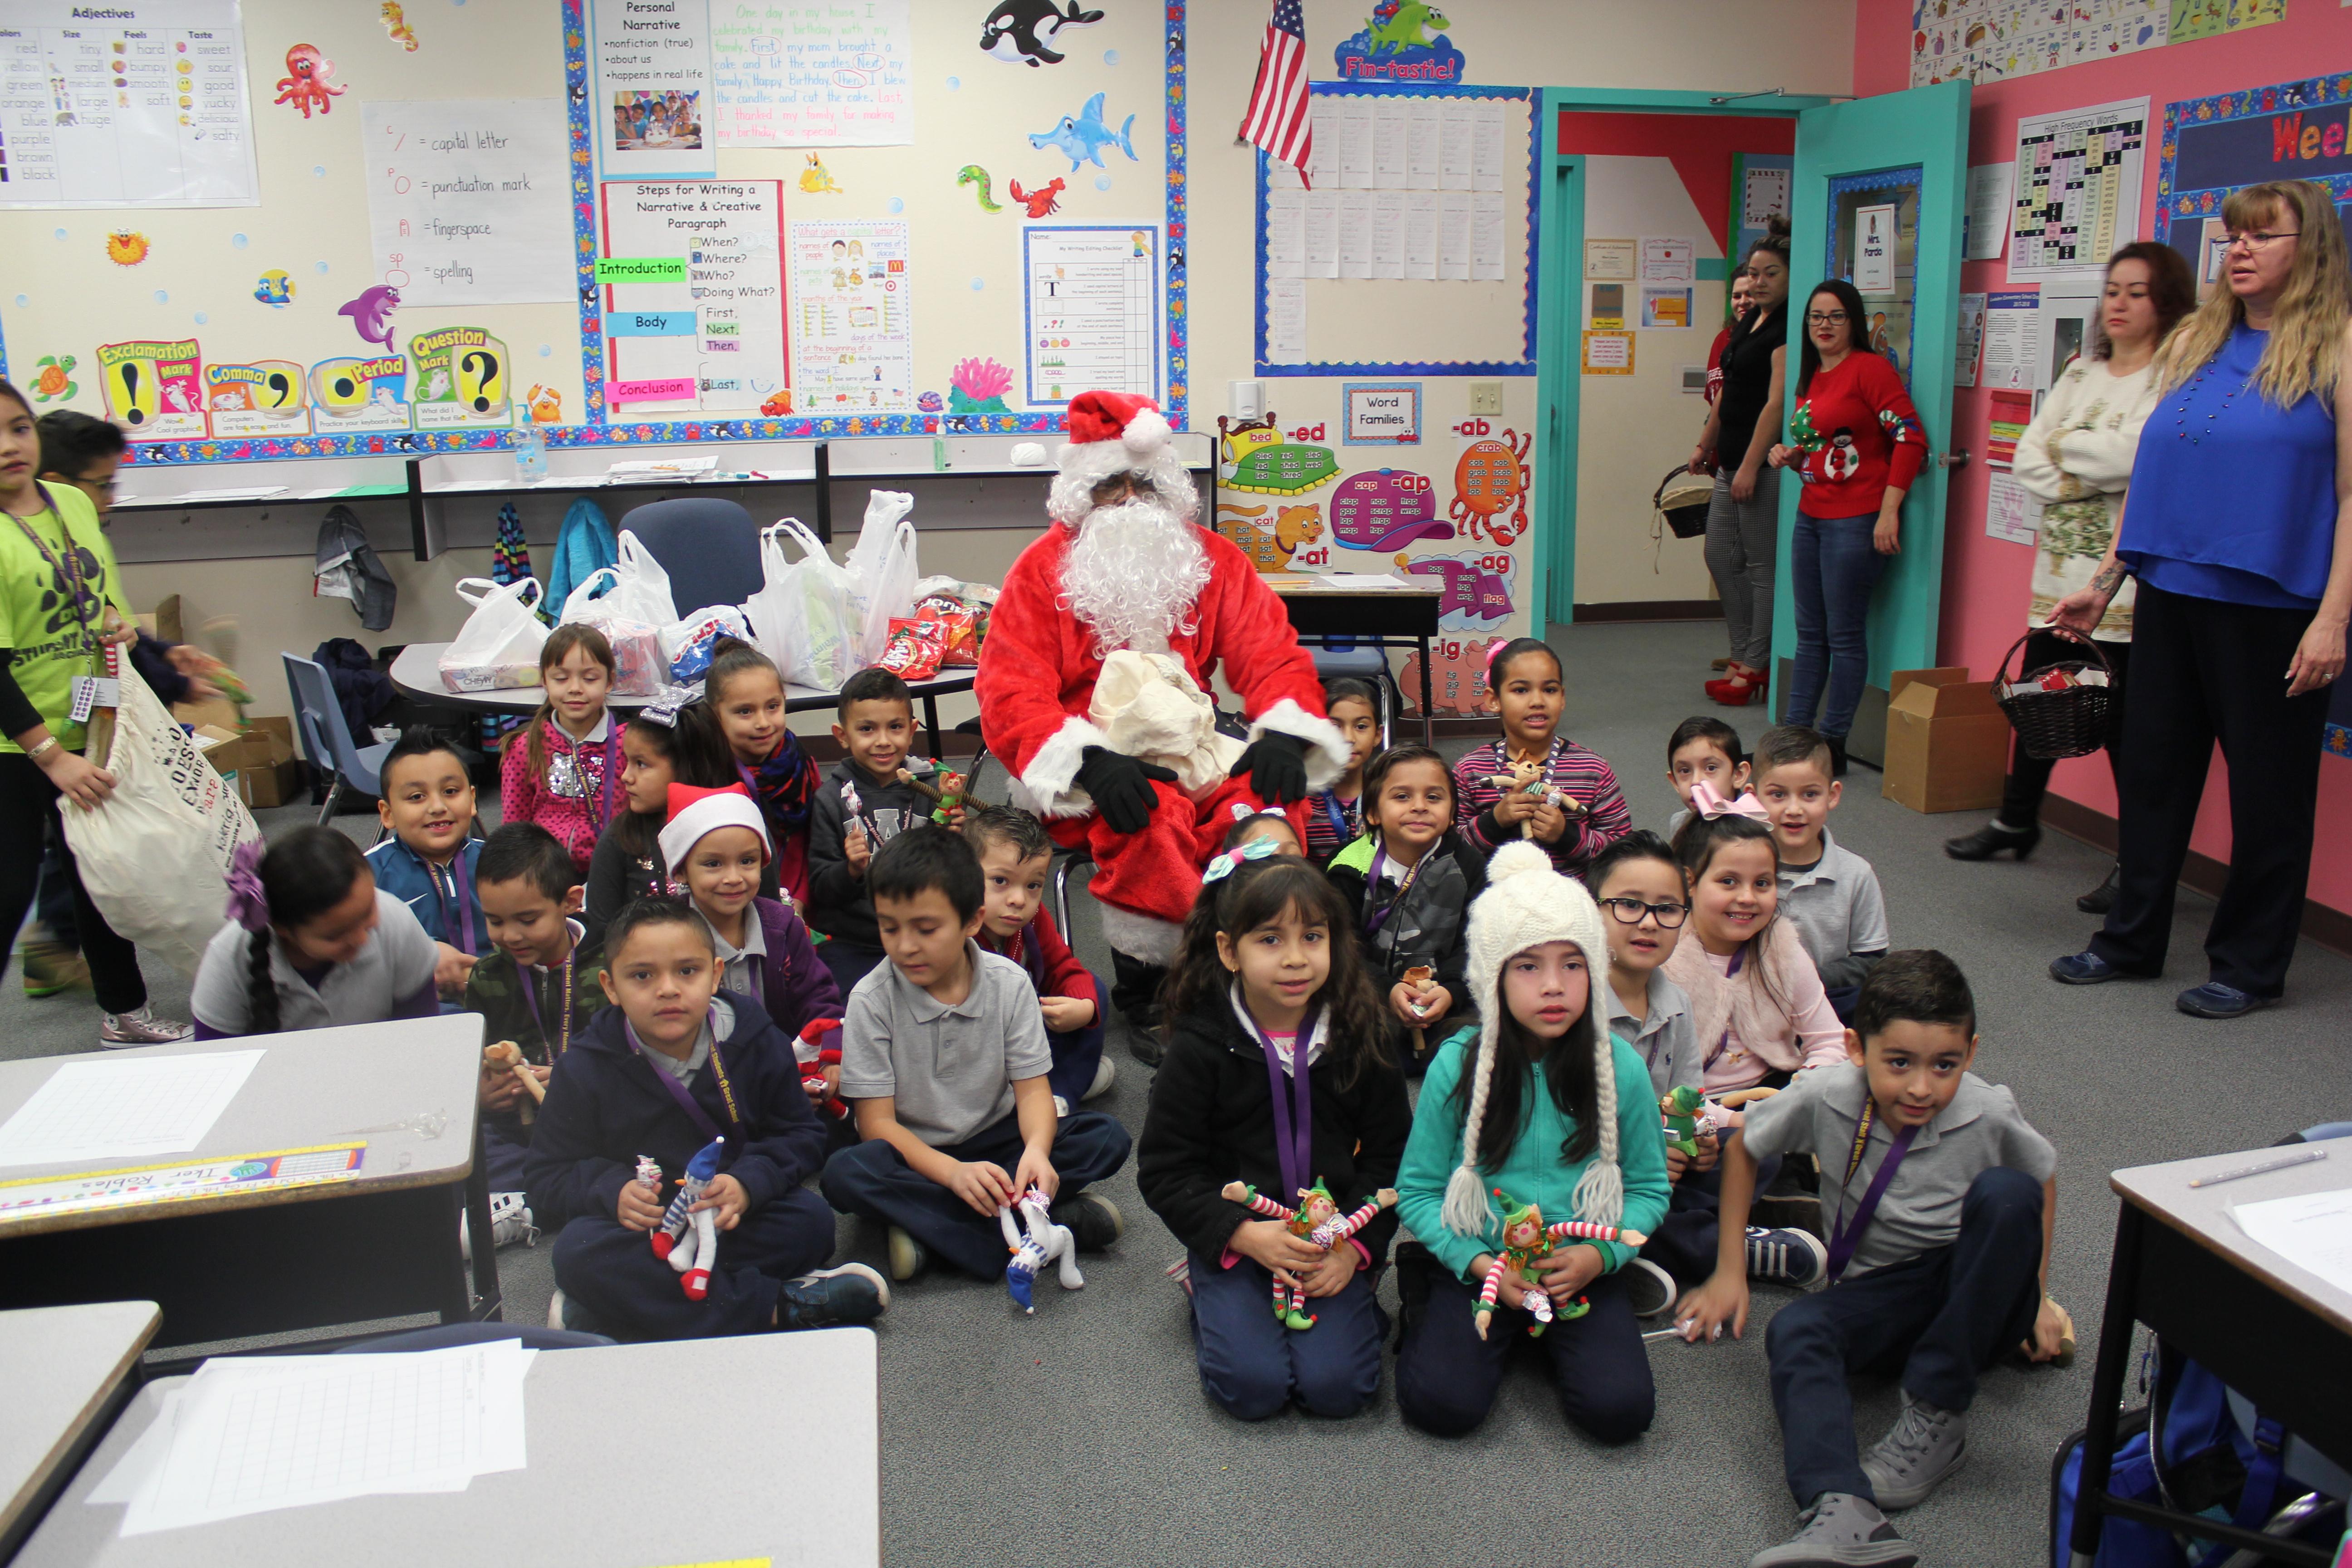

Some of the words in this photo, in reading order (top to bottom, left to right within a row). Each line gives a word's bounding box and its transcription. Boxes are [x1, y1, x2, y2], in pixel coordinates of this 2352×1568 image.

[72, 7, 135, 20] Adjectives
[627, 2, 675, 13] Personal
[623, 20, 680, 30] Narrative
[2135, 15, 2145, 24] ue
[124, 30, 147, 39] Feels
[2073, 31, 2081, 39] ee
[197, 44, 231, 54] sweet
[610, 39, 658, 48] nonfiction
[664, 38, 693, 49] (true)
[610, 54, 636, 64] about
[129, 61, 166, 73] bumpy
[1346, 57, 1454, 79] Fin-tastic!
[612, 70, 650, 81] happens
[653, 70, 662, 78] in
[665, 70, 683, 78] real
[686, 70, 703, 79] life
[129, 78, 169, 88] smooth
[205, 79, 235, 93] good
[717, 91, 731, 103] the
[738, 91, 772, 103] candles
[779, 91, 796, 102] and
[803, 91, 819, 102] cut
[828, 91, 842, 102] the
[2, 99, 45, 113] orange
[203, 98, 235, 111] yucky
[81, 113, 110, 128] huge
[198, 114, 239, 123] delicious
[718, 107, 724, 121] I
[735, 107, 772, 120] thanked
[783, 109, 799, 121] my
[806, 107, 834, 122] family
[843, 107, 856, 119] for
[863, 107, 895, 122] making
[2045, 124, 2059, 133] High
[2061, 118, 2095, 130] Frequency
[2097, 114, 2118, 123] Words
[431, 131, 468, 153] capital
[477, 131, 508, 149] letter
[17, 152, 54, 162] brown
[23, 169, 55, 180] black
[432, 175, 494, 199] punctuation
[503, 172, 531, 191] mark
[637, 185, 671, 196] Steps
[676, 185, 695, 196] for
[700, 185, 743, 197] Writing
[637, 201, 695, 211] Narrative
[700, 202, 707, 211] &
[713, 201, 761, 211] Creative
[433, 218, 491, 240] fingerspace
[668, 218, 726, 229] Paragraph
[799, 227, 818, 235] What
[821, 228, 838, 238] gets
[848, 228, 872, 237] capital
[875, 226, 901, 235] letter?
[701, 237, 738, 247] When?
[1867, 235, 1880, 244] Mrs.
[703, 254, 747, 263] Where?
[1865, 248, 1882, 257] Pardo
[433, 260, 473, 284] spelling
[599, 262, 681, 274] Introduction
[703, 270, 735, 280] Who?
[703, 287, 734, 298] Doing
[738, 287, 775, 297] What?
[1044, 282, 1059, 296] T
[706, 308, 738, 318] First,
[636, 317, 666, 329] Body
[706, 324, 739, 335] Next,
[413, 328, 484, 357] Question
[706, 341, 738, 352] Then,
[99, 341, 198, 363] Exclamation
[419, 356, 449, 371] Mark
[162, 364, 192, 378] Mark
[208, 366, 265, 383] Comma
[352, 358, 403, 382] Period
[619, 381, 684, 396] Conclusion
[711, 379, 739, 390] Last,
[1367, 397, 1399, 407] Word
[1361, 414, 1404, 425] Families
[1289, 422, 1325, 441] -ed
[1453, 418, 1490, 437] -ab
[1250, 433, 1271, 441] bed
[1477, 444, 1501, 452] crab
[1355, 481, 1376, 490] cap
[1392, 476, 1430, 494] -ap
[1256, 517, 1274, 525] cat
[1298, 547, 1329, 564] -at
[1474, 556, 1509, 574] -ag
[1484, 595, 1504, 604] flag
[1433, 639, 1460, 660] -ig
[712, 1052, 724, 1078] Students
[723, 1087, 733, 1104] Great
[172, 1166, 221, 1179] Iker
